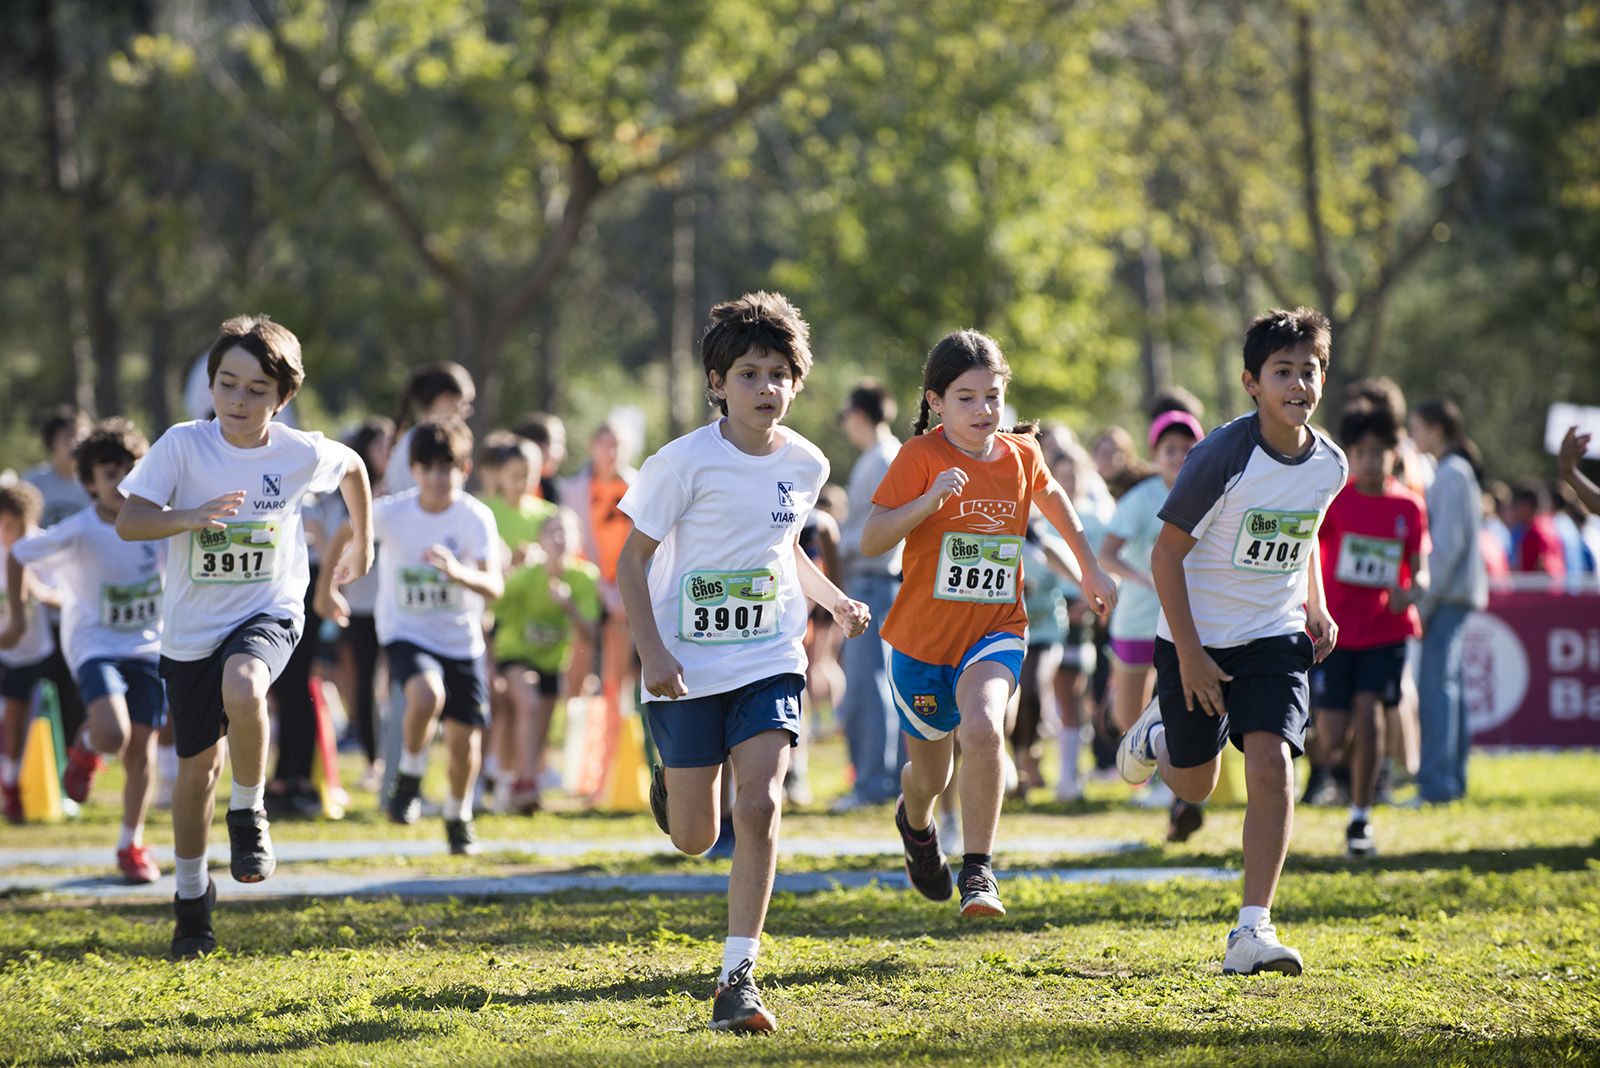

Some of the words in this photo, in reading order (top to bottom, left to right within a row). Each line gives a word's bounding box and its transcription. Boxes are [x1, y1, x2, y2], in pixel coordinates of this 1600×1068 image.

[253, 499, 286, 509] VIARÓ
[1251, 519, 1277, 532] CROS
[200, 531, 227, 545] CROS
[952, 544, 979, 557] CROS
[1246, 539, 1301, 562] 4704
[203, 551, 263, 572] 3917
[948, 565, 1006, 589] 3626
[692, 581, 723, 598] CROS
[694, 604, 763, 631] 3907
